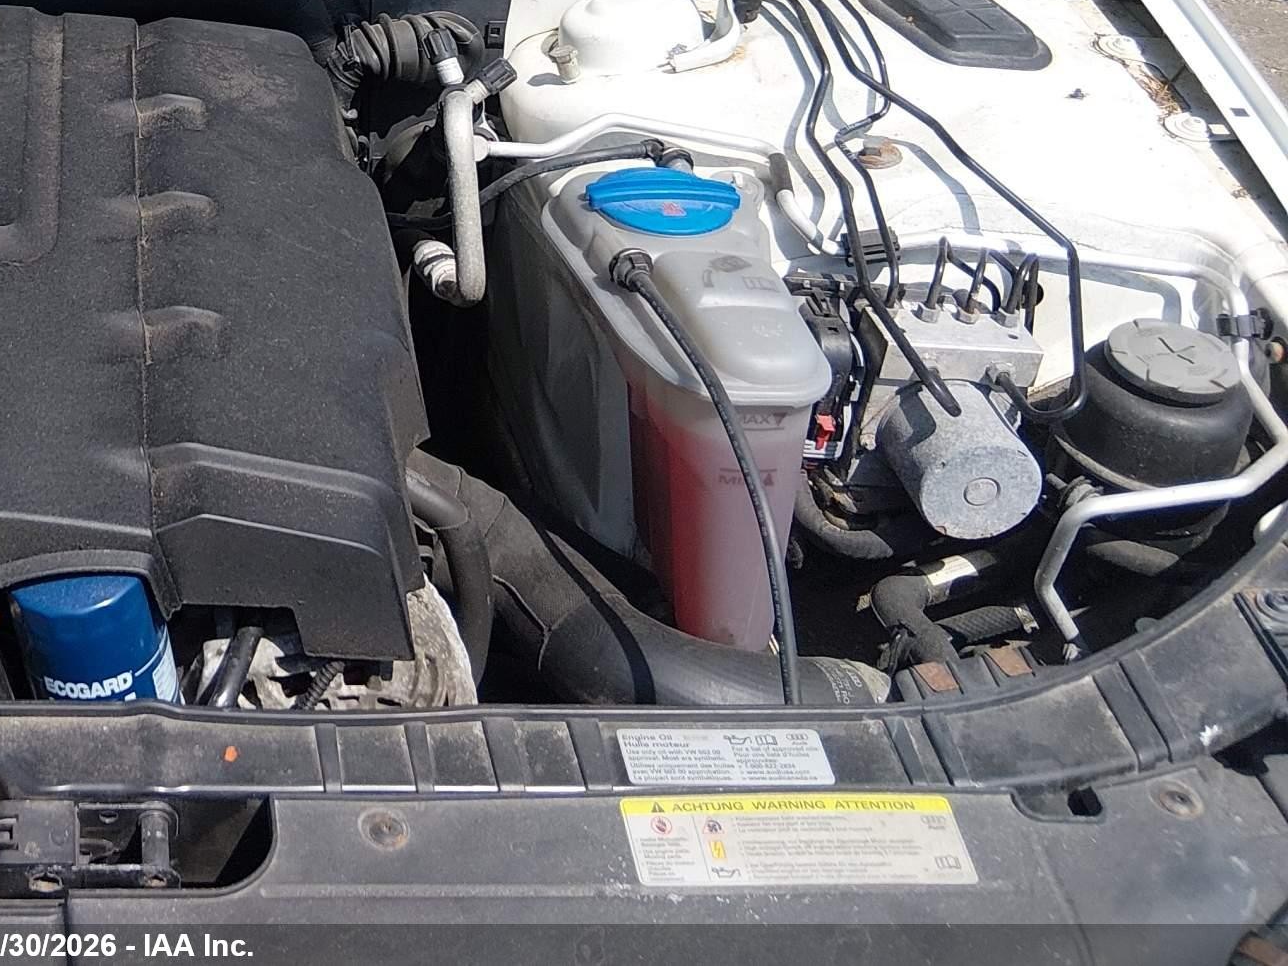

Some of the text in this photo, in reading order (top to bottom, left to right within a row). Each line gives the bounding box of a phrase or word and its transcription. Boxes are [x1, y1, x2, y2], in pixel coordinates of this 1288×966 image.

[719, 473, 743, 485] MI
[44, 672, 133, 700] ECOGARD
[672, 799, 916, 812] ACHTUNG WARNING ATTENTION
